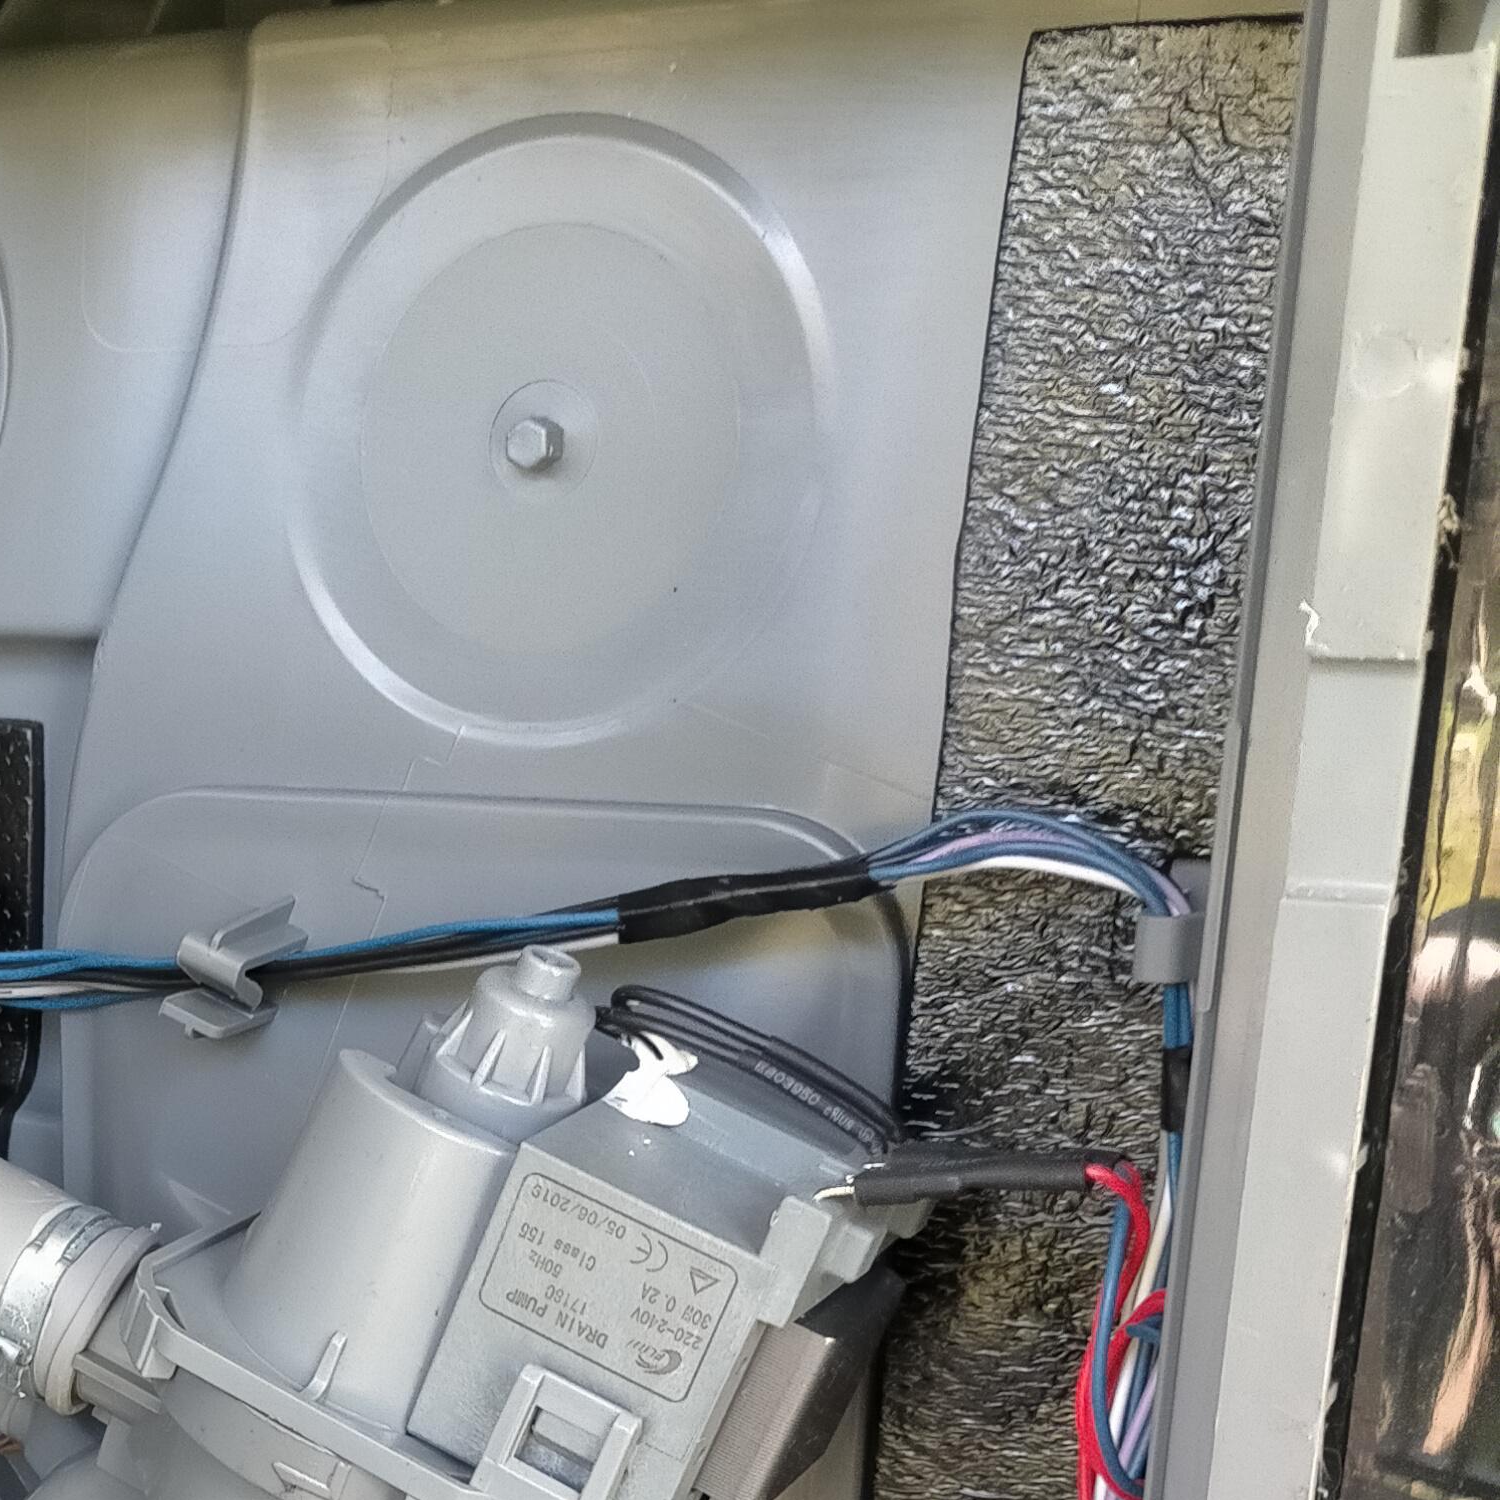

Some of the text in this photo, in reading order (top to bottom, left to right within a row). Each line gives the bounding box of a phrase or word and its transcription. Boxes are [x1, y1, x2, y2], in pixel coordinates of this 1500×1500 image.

[518, 1221, 597, 1272] Class 155
[528, 1249, 563, 1279] 50Hz
[505, 1288, 609, 1350] DRAIN PUMP
